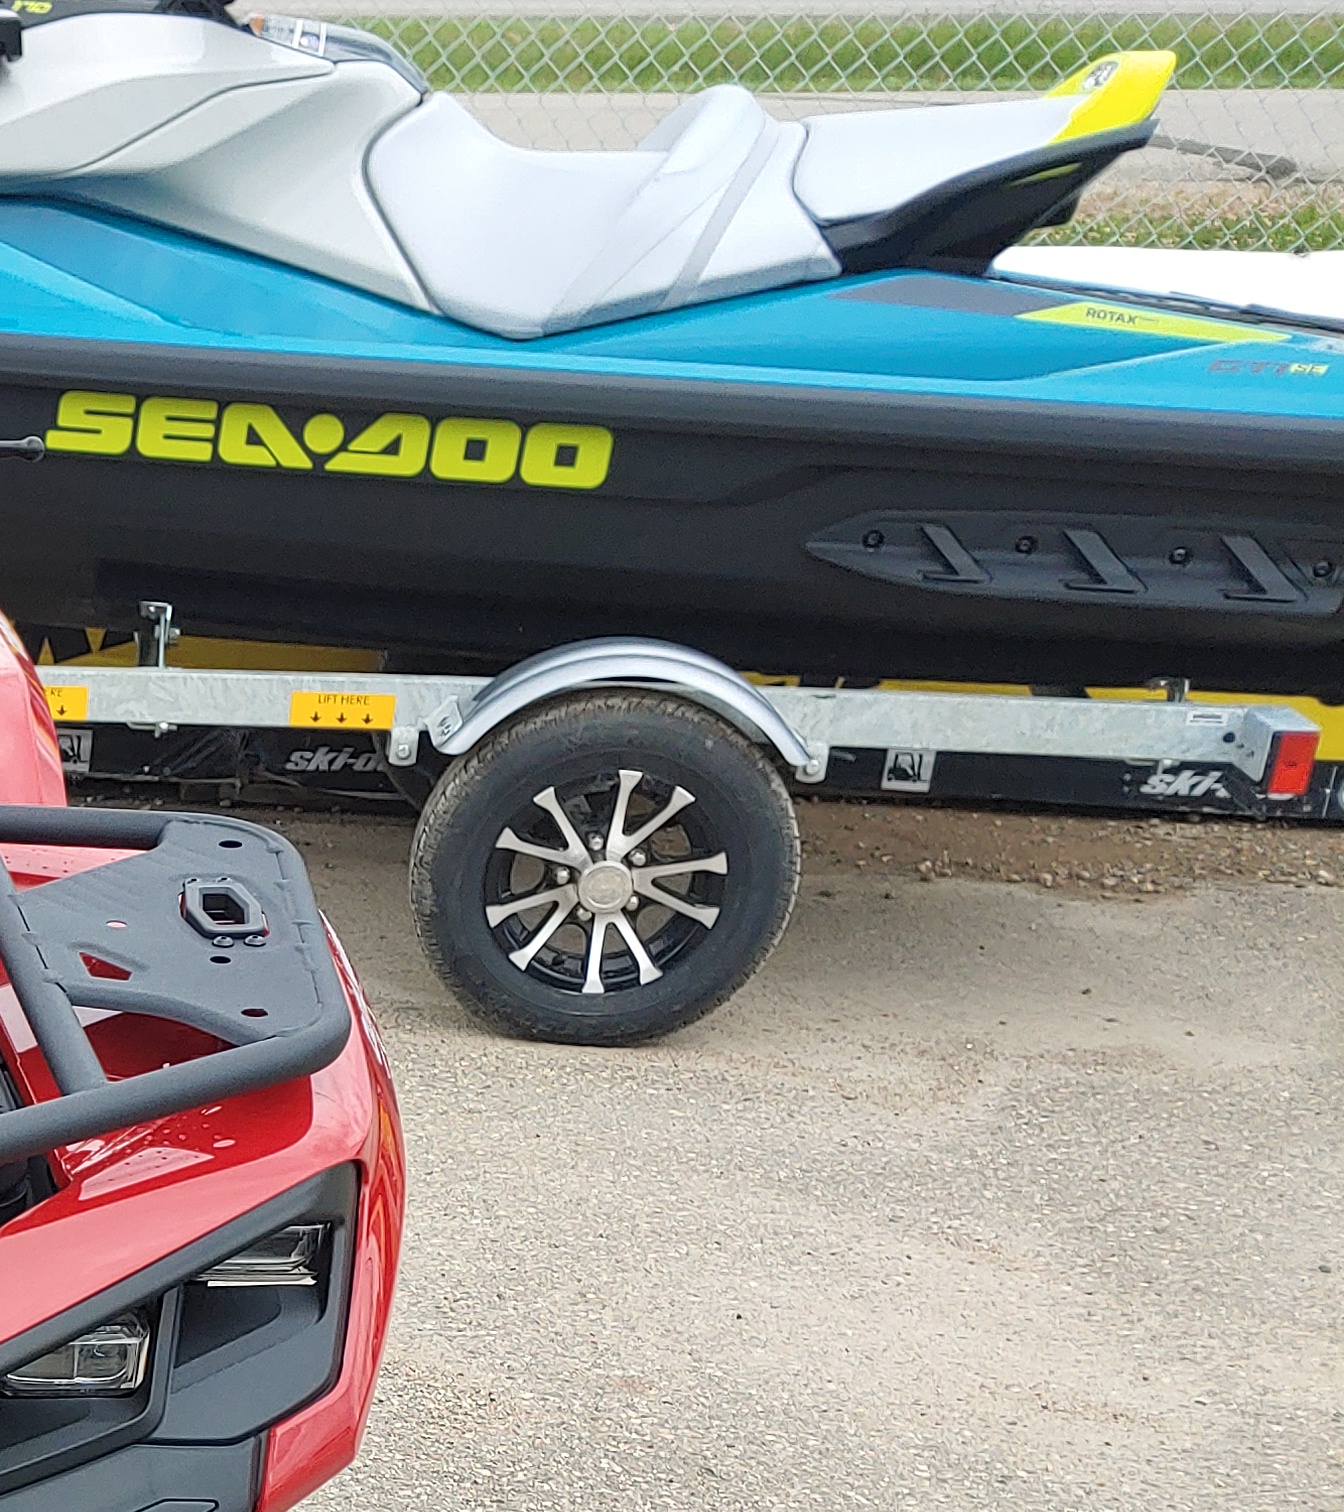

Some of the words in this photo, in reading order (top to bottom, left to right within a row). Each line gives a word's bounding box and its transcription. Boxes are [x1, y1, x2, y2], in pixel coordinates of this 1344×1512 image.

[1085, 308, 1139, 326] ROTAX
[318, 693, 338, 705] LIFT
[340, 694, 371, 706] HERE
